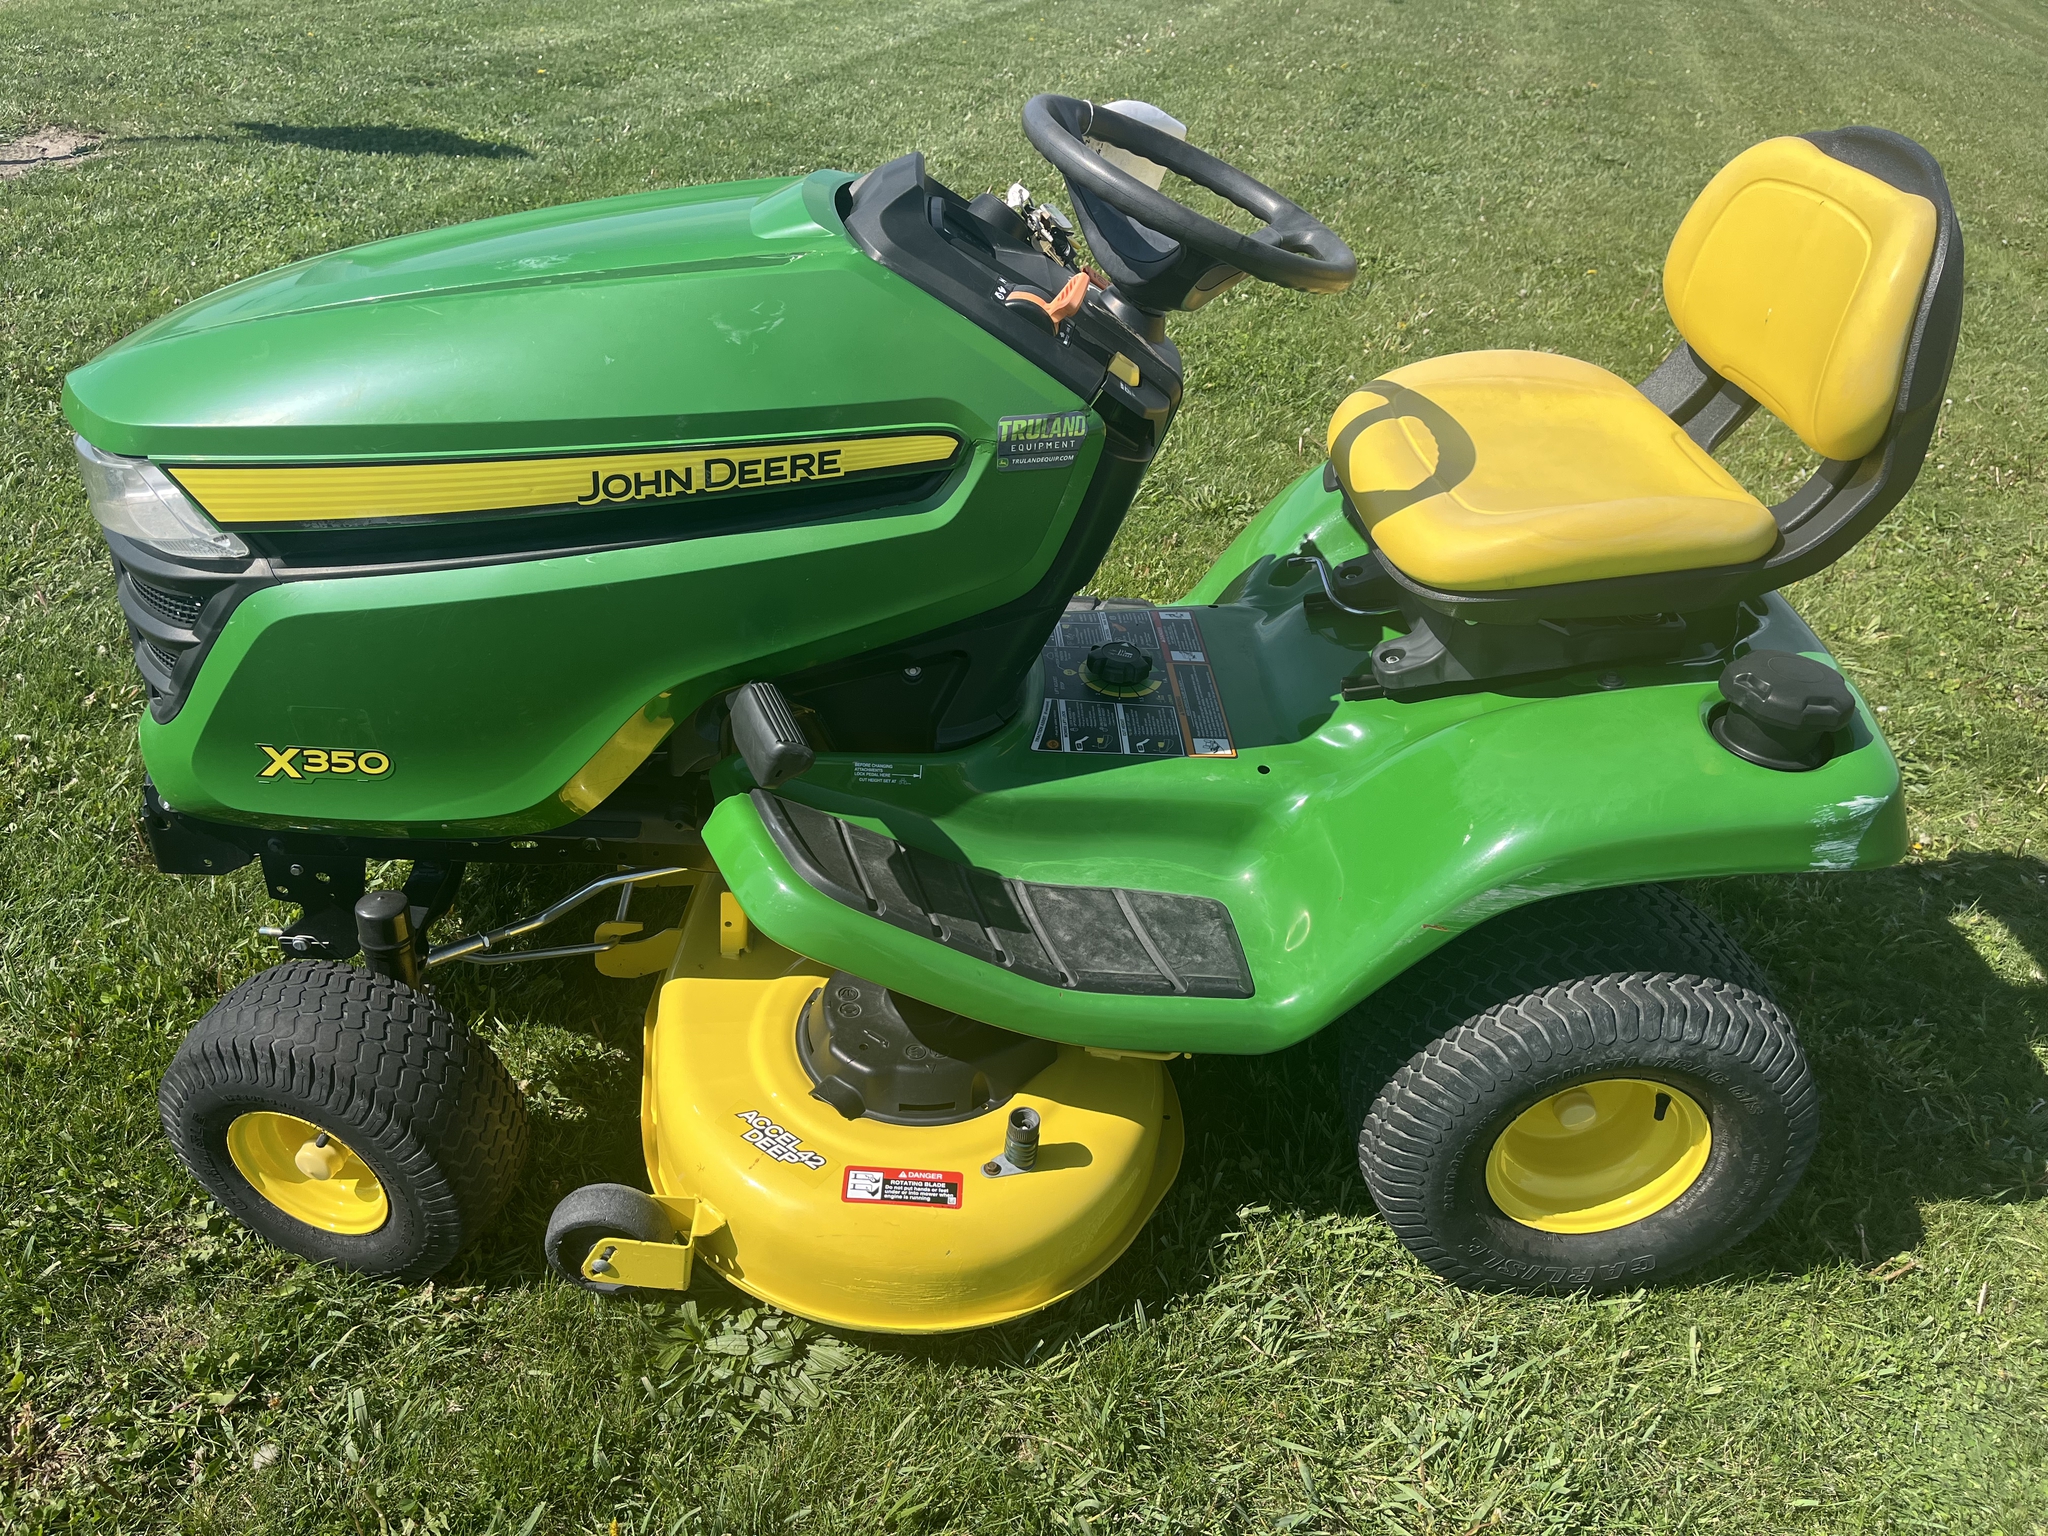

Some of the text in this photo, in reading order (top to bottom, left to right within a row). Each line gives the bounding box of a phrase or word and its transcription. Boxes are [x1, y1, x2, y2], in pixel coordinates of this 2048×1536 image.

[1000, 416, 1086, 442] TRULAND
[1011, 440, 1075, 452] EQUIPMENT
[578, 450, 842, 503] JOHN DEERE
[1012, 455, 1074, 464] TRULANDEQUIP.COM
[258, 745, 392, 780] X350
[735, 1110, 826, 1170] ACCEL 42
[740, 1128, 800, 1164] DEEP
[1457, 1236, 1658, 1283] CARLISLE
